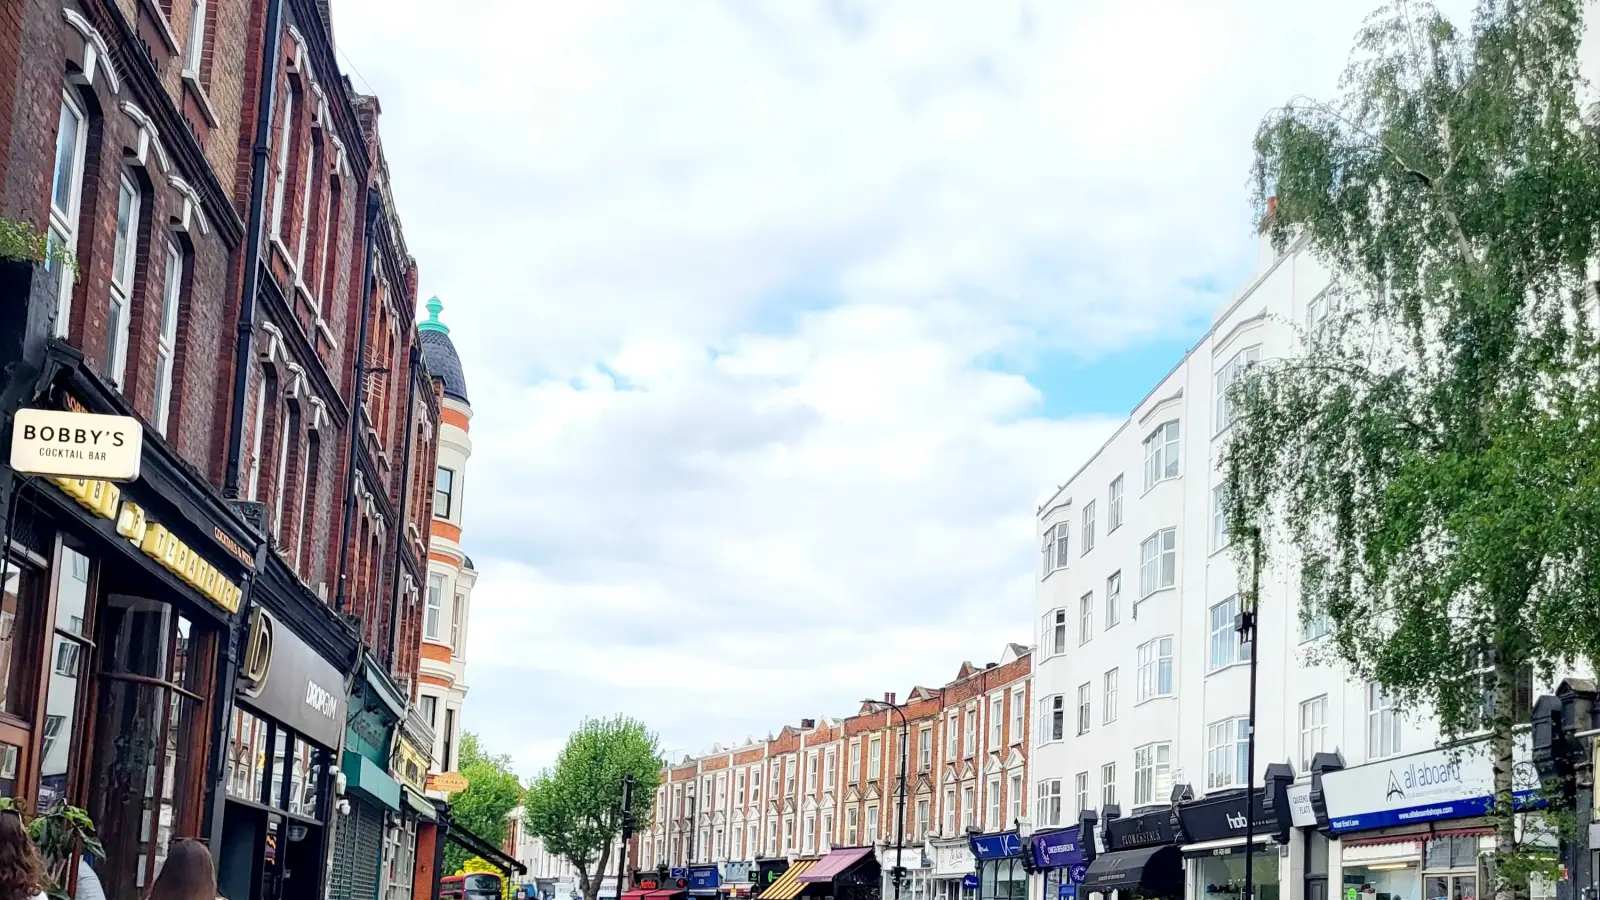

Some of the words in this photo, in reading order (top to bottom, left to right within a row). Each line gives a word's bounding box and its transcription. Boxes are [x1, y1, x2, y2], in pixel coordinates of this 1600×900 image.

[24, 424, 125, 447] BOBBY'S
[39, 447, 84, 460] COCKTAIL
[88, 451, 107, 461] BAR
[1404, 763, 1417, 788] all
[1419, 761, 1461, 786] aboard
[1226, 811, 1247, 829] hob
